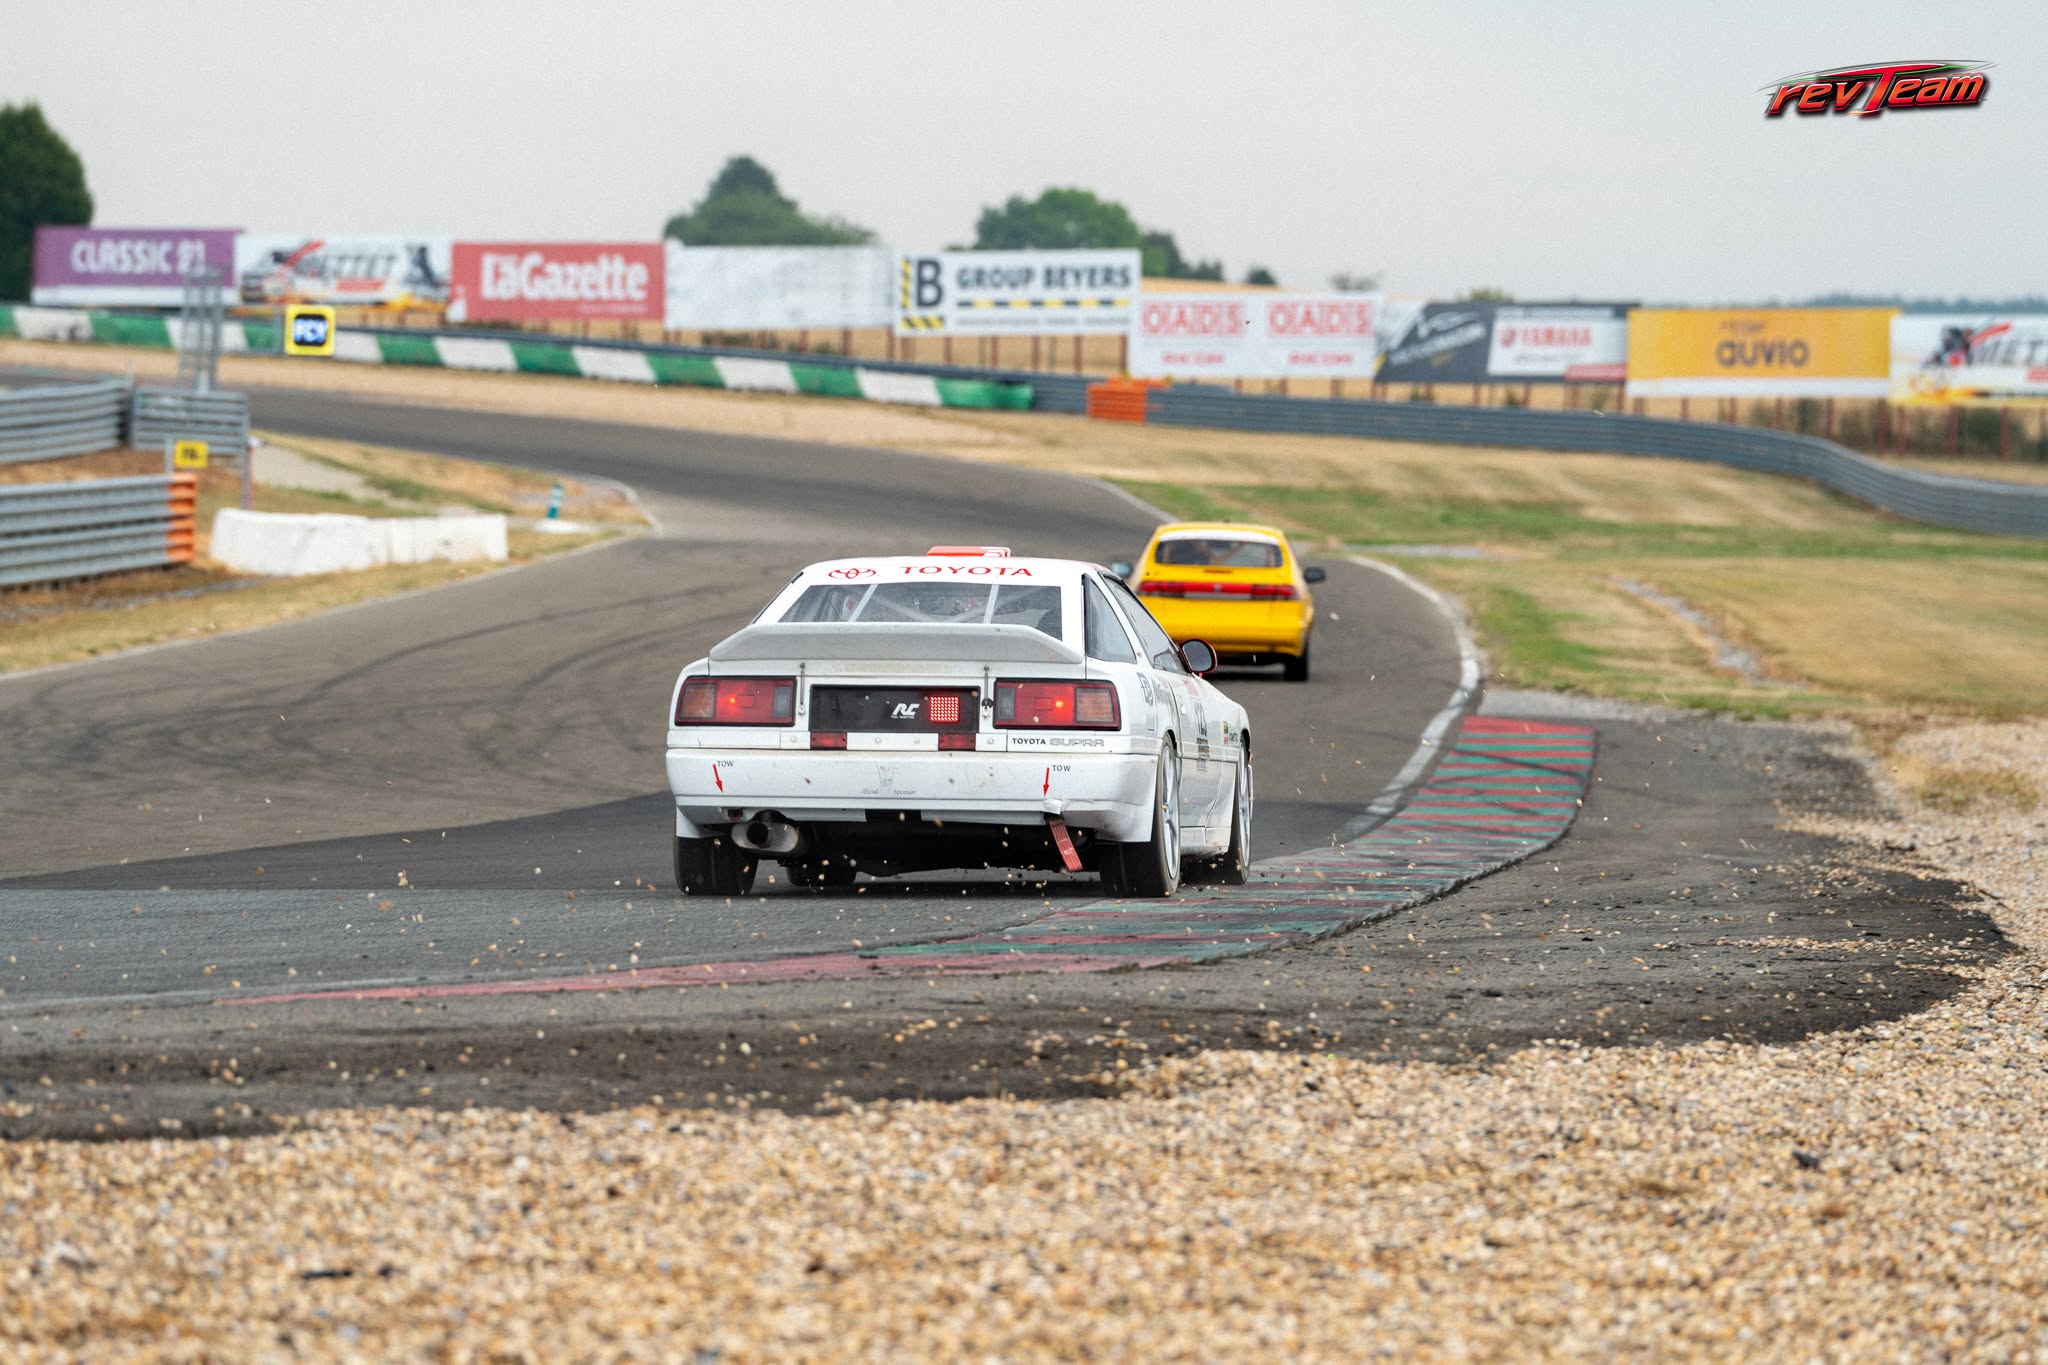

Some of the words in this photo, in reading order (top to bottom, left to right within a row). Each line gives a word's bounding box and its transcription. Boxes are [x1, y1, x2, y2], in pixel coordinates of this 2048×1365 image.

[71, 239, 173, 274] CLASSIC
[916, 259, 944, 308] B
[956, 266, 1034, 290] GROUP
[1042, 264, 1131, 288] BEYERS
[1715, 338, 1811, 368] auvio
[900, 565, 1033, 577] TOYOTA
[1012, 737, 1047, 745] TOYOTA
[1049, 737, 1105, 747] SUPRA
[717, 760, 734, 768] TOW
[1052, 764, 1071, 772] TOW
